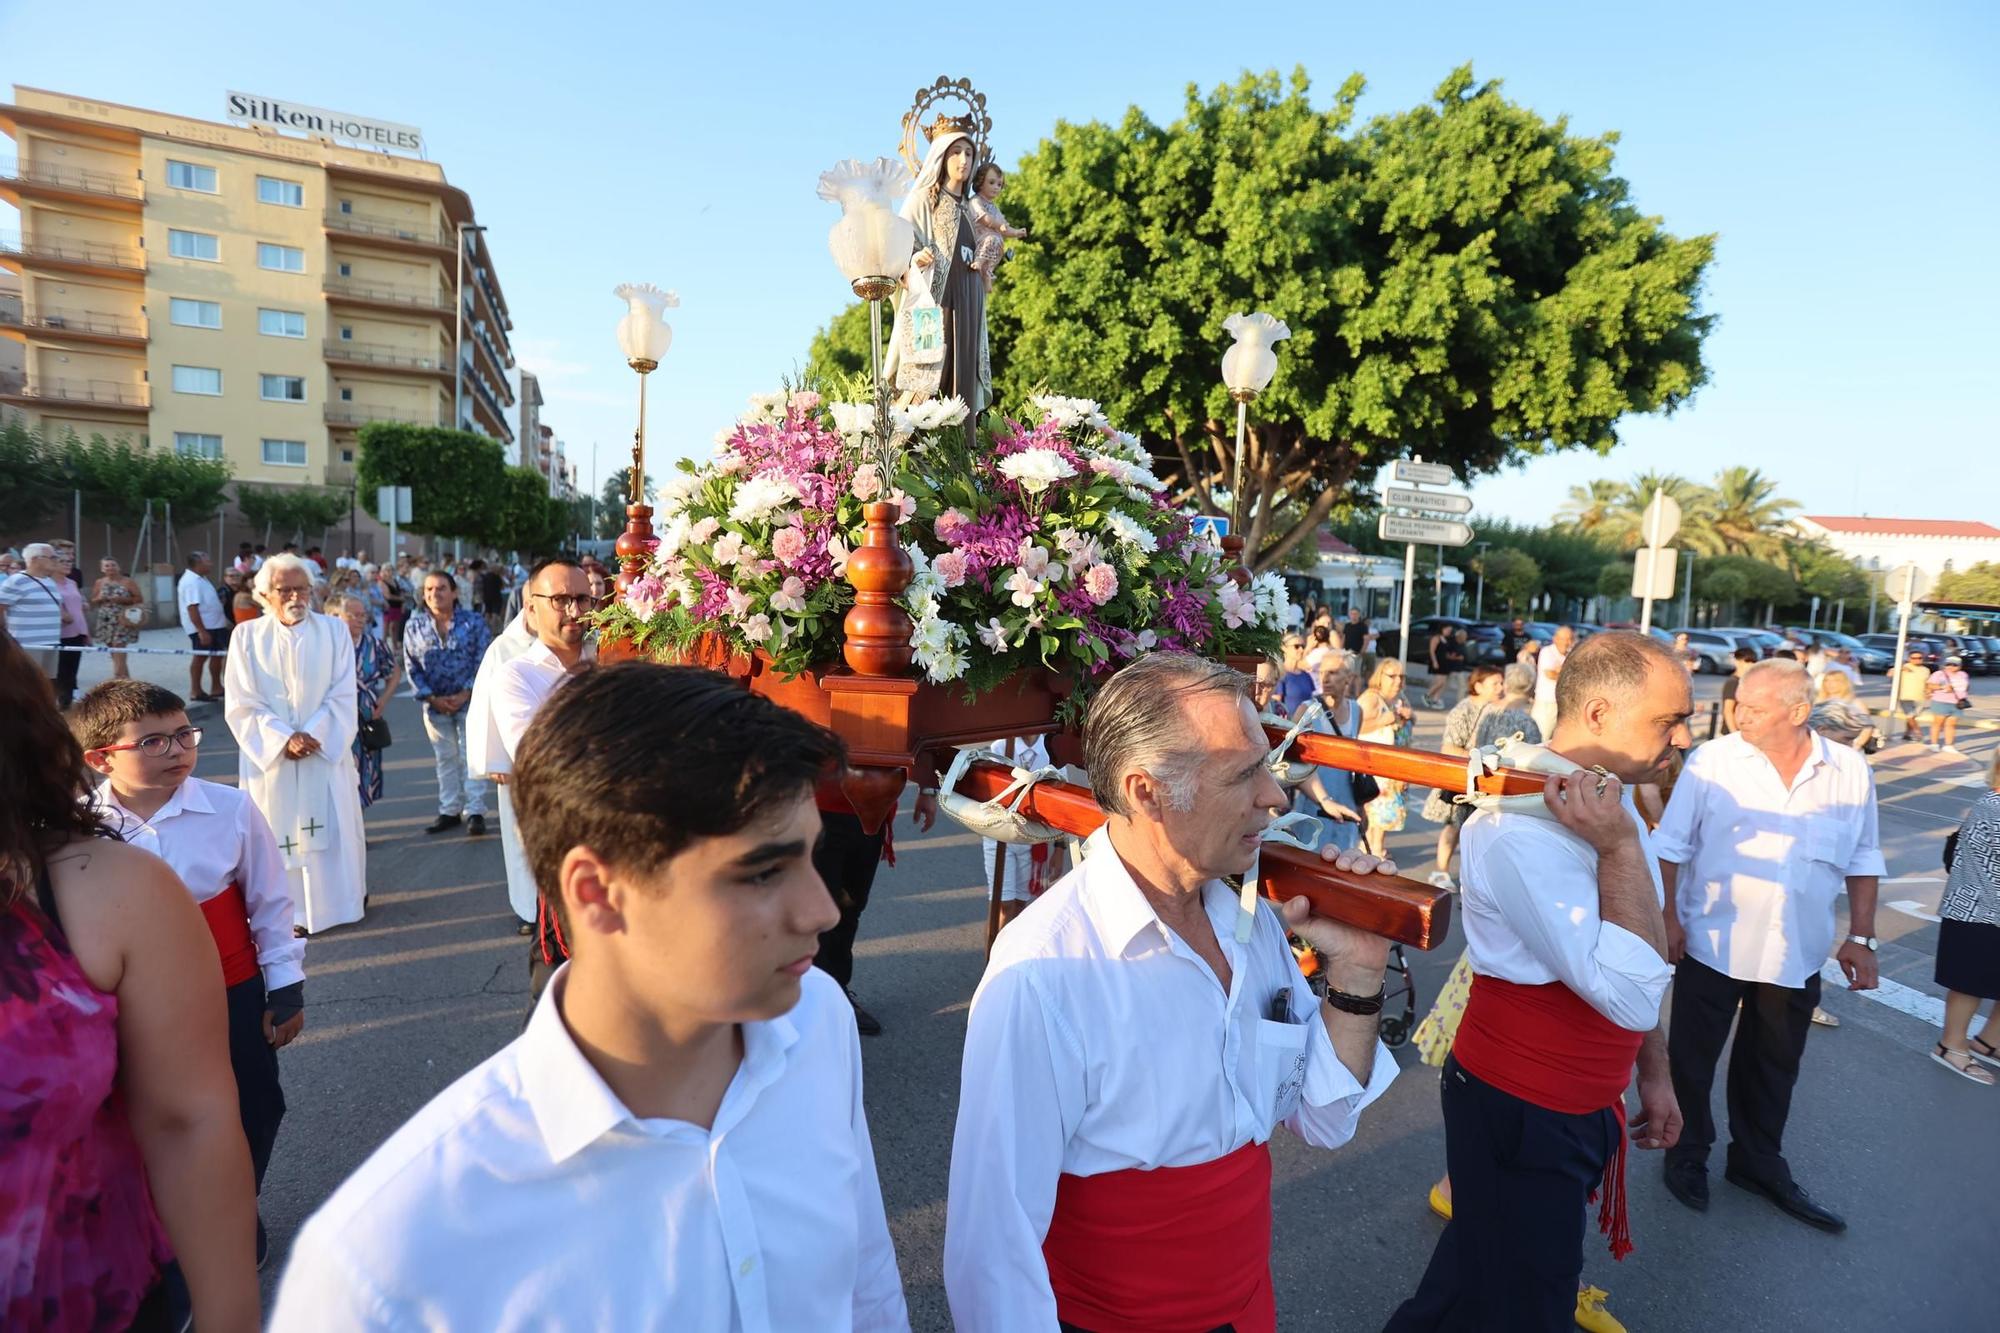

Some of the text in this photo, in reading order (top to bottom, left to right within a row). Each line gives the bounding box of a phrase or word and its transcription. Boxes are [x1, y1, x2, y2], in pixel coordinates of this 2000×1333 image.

[230, 95, 420, 149] Silken HOTELES
[1392, 493, 1411, 503] CLUB
